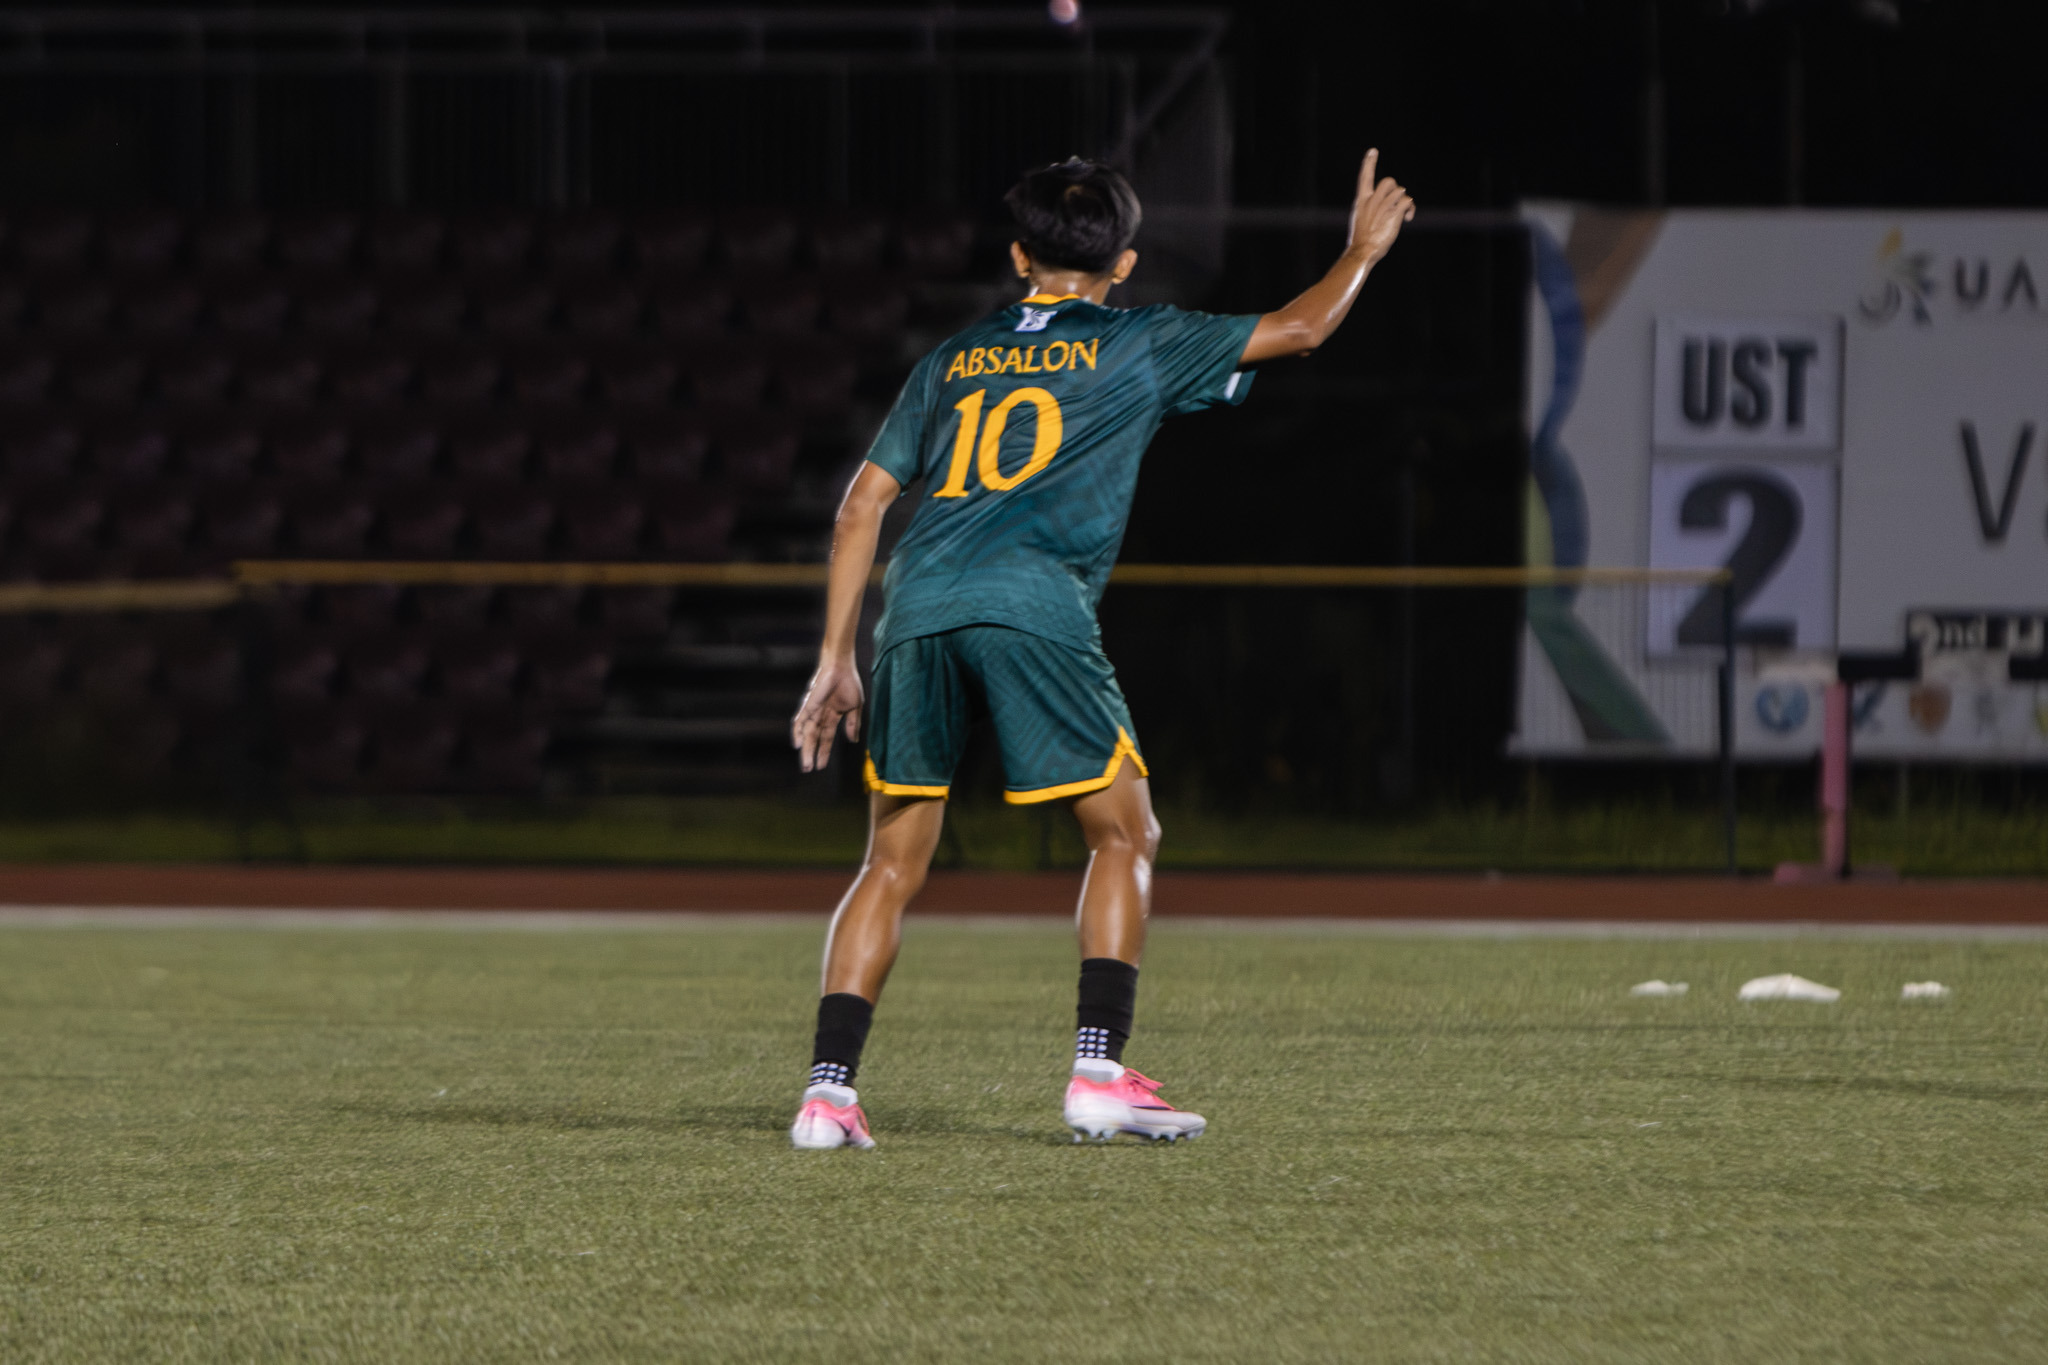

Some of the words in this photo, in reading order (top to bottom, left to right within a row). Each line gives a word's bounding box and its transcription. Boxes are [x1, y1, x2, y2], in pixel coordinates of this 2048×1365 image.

[945, 337, 1100, 382] ABSALON
[1681, 339, 1818, 432] UST
[932, 386, 1064, 498] 10
[1676, 467, 1803, 648] 2
